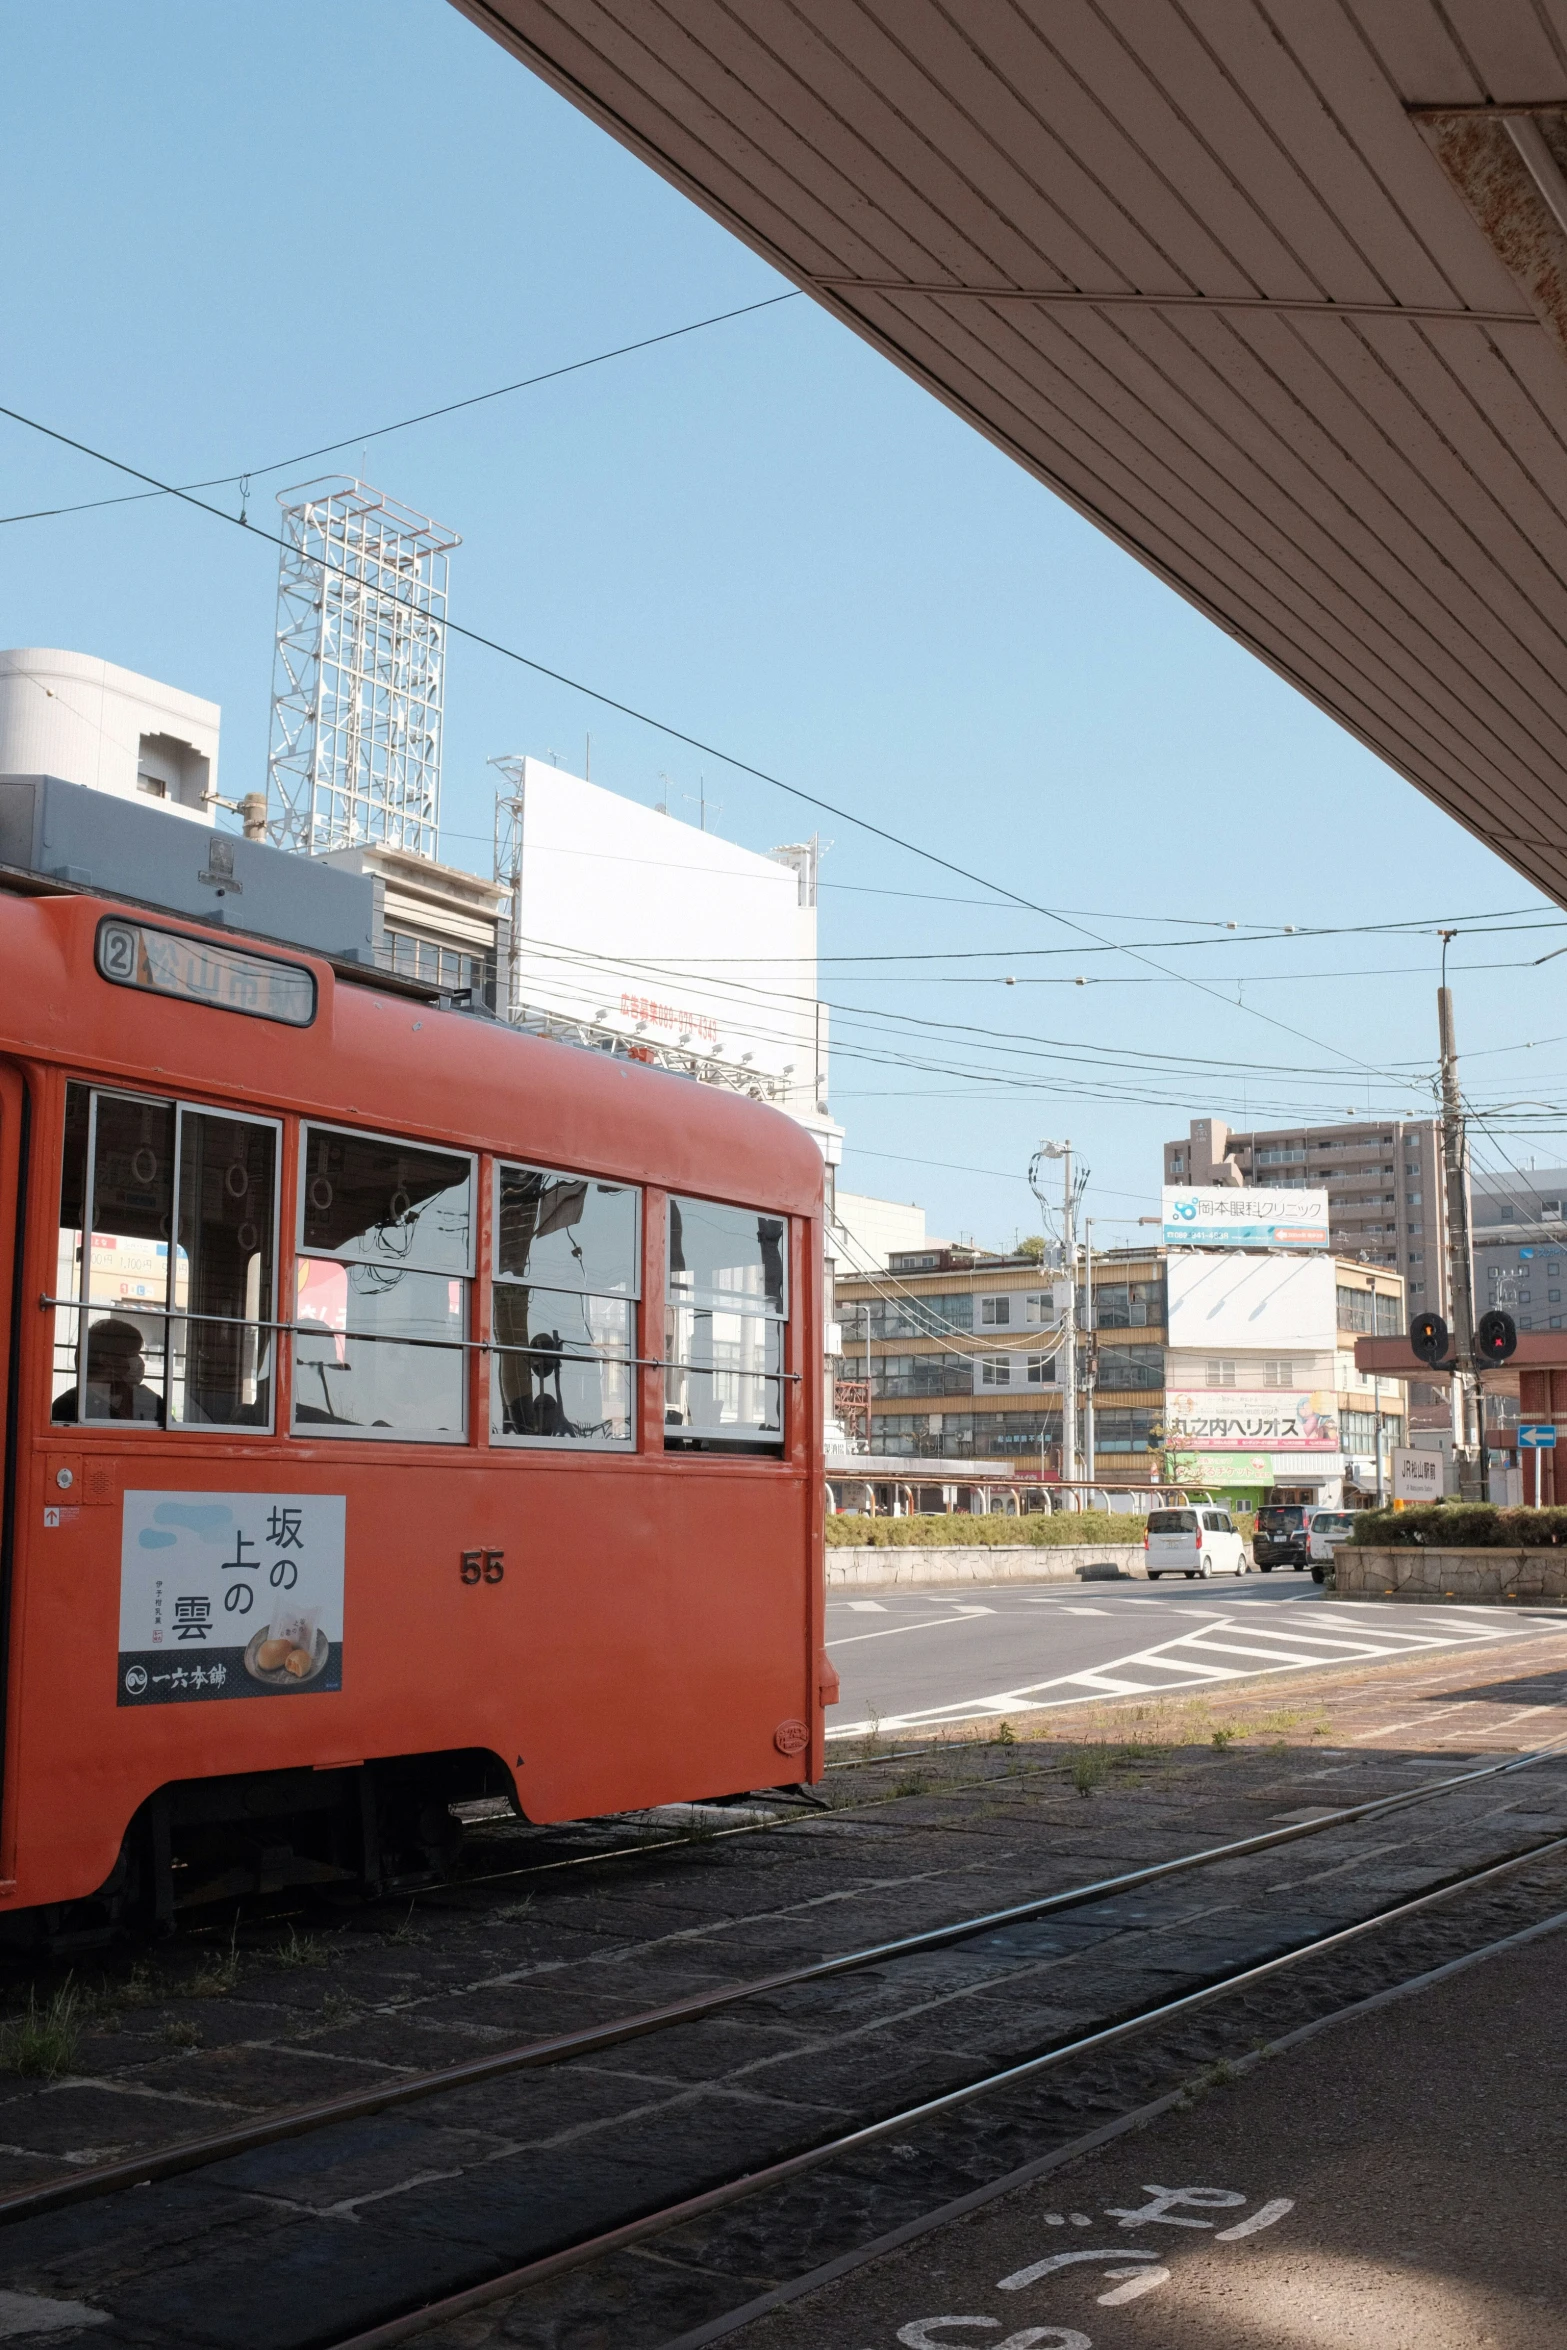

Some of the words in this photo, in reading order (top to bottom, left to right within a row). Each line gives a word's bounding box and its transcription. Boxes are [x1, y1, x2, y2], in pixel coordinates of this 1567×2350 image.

[109, 936, 128, 970] 2
[1198, 1199, 1321, 1218] 岡本眼科クリニック
[1172, 1417, 1299, 1437] 丸之内ヘリオス
[1401, 1459, 1436, 1480] JR松山駅前
[265, 1504, 305, 1590] 坂の
[221, 1529, 261, 1615] 上の
[460, 1550, 504, 1585] 55
[171, 1595, 213, 1642] 雲
[152, 1663, 227, 1690] 一六本舗
